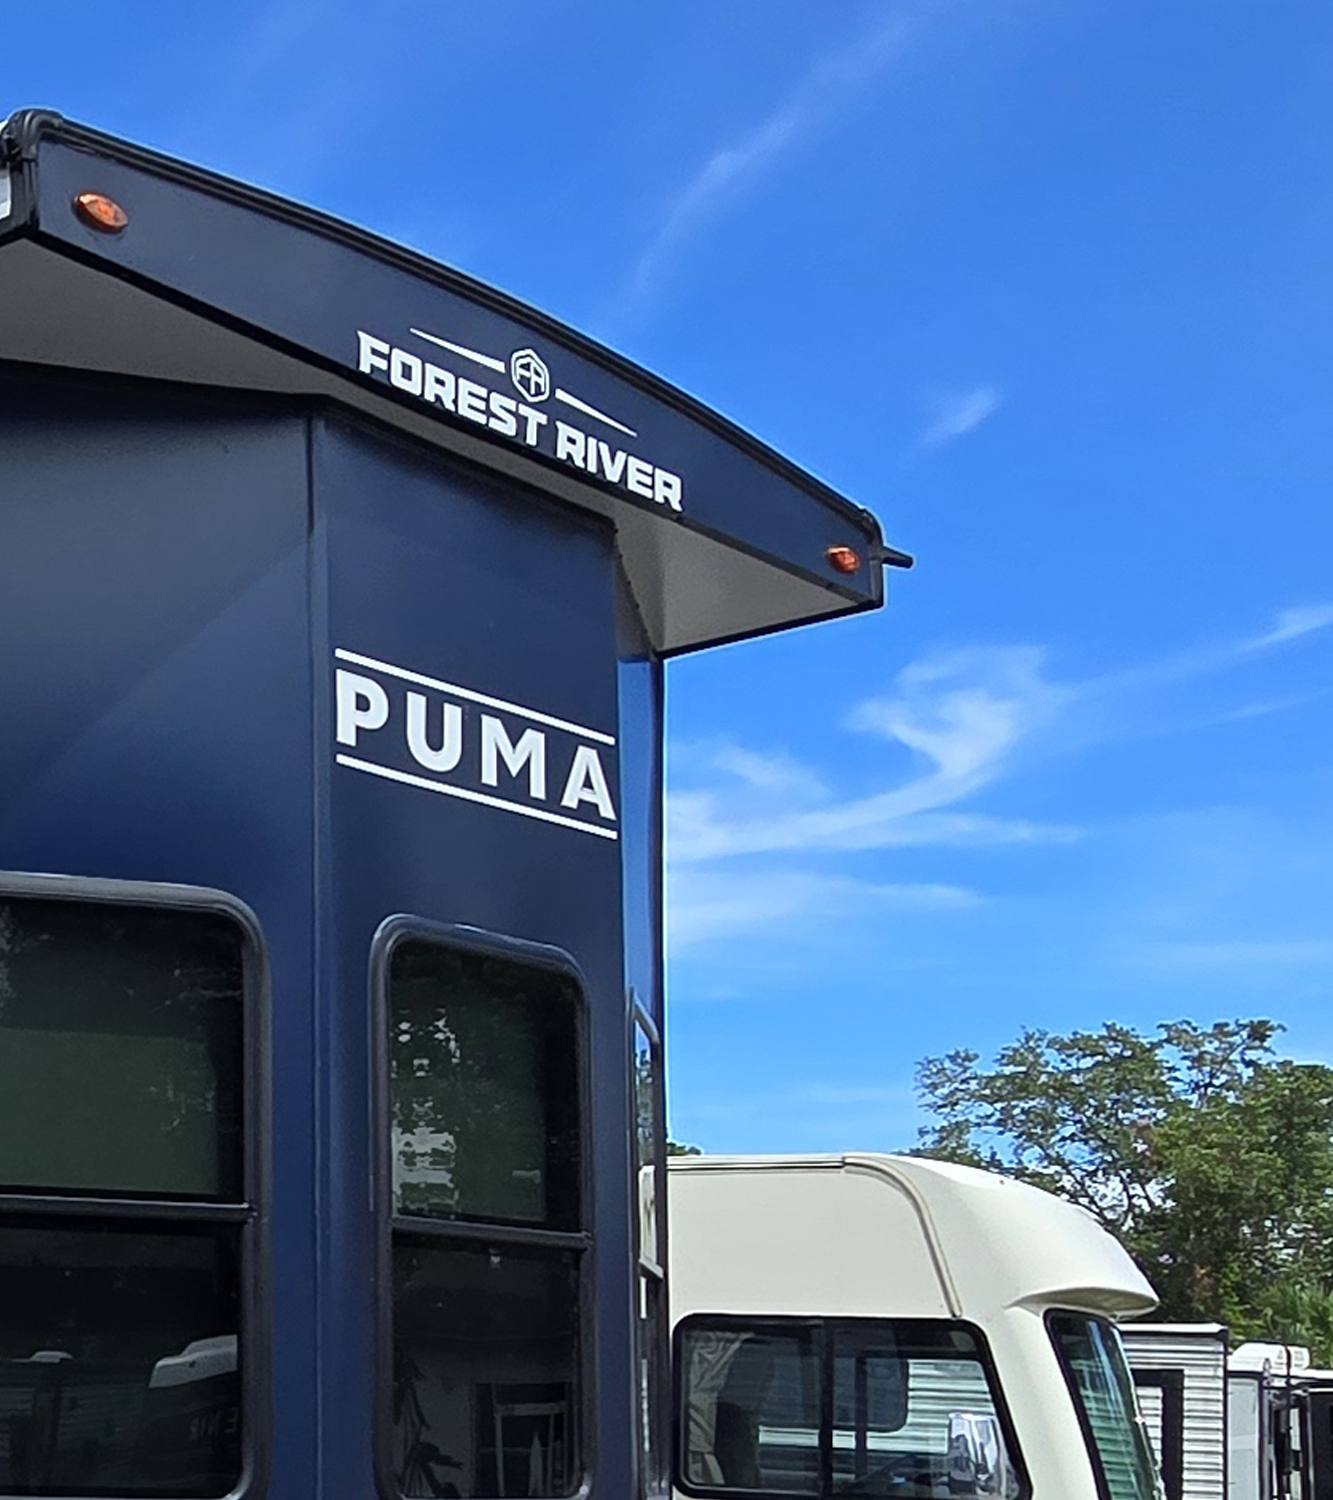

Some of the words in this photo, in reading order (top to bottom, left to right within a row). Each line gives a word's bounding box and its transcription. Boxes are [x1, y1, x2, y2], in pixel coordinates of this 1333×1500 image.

[356, 330, 550, 447] FOREST
[555, 420, 684, 513] RIVER
[335, 668, 617, 821] PUMA
